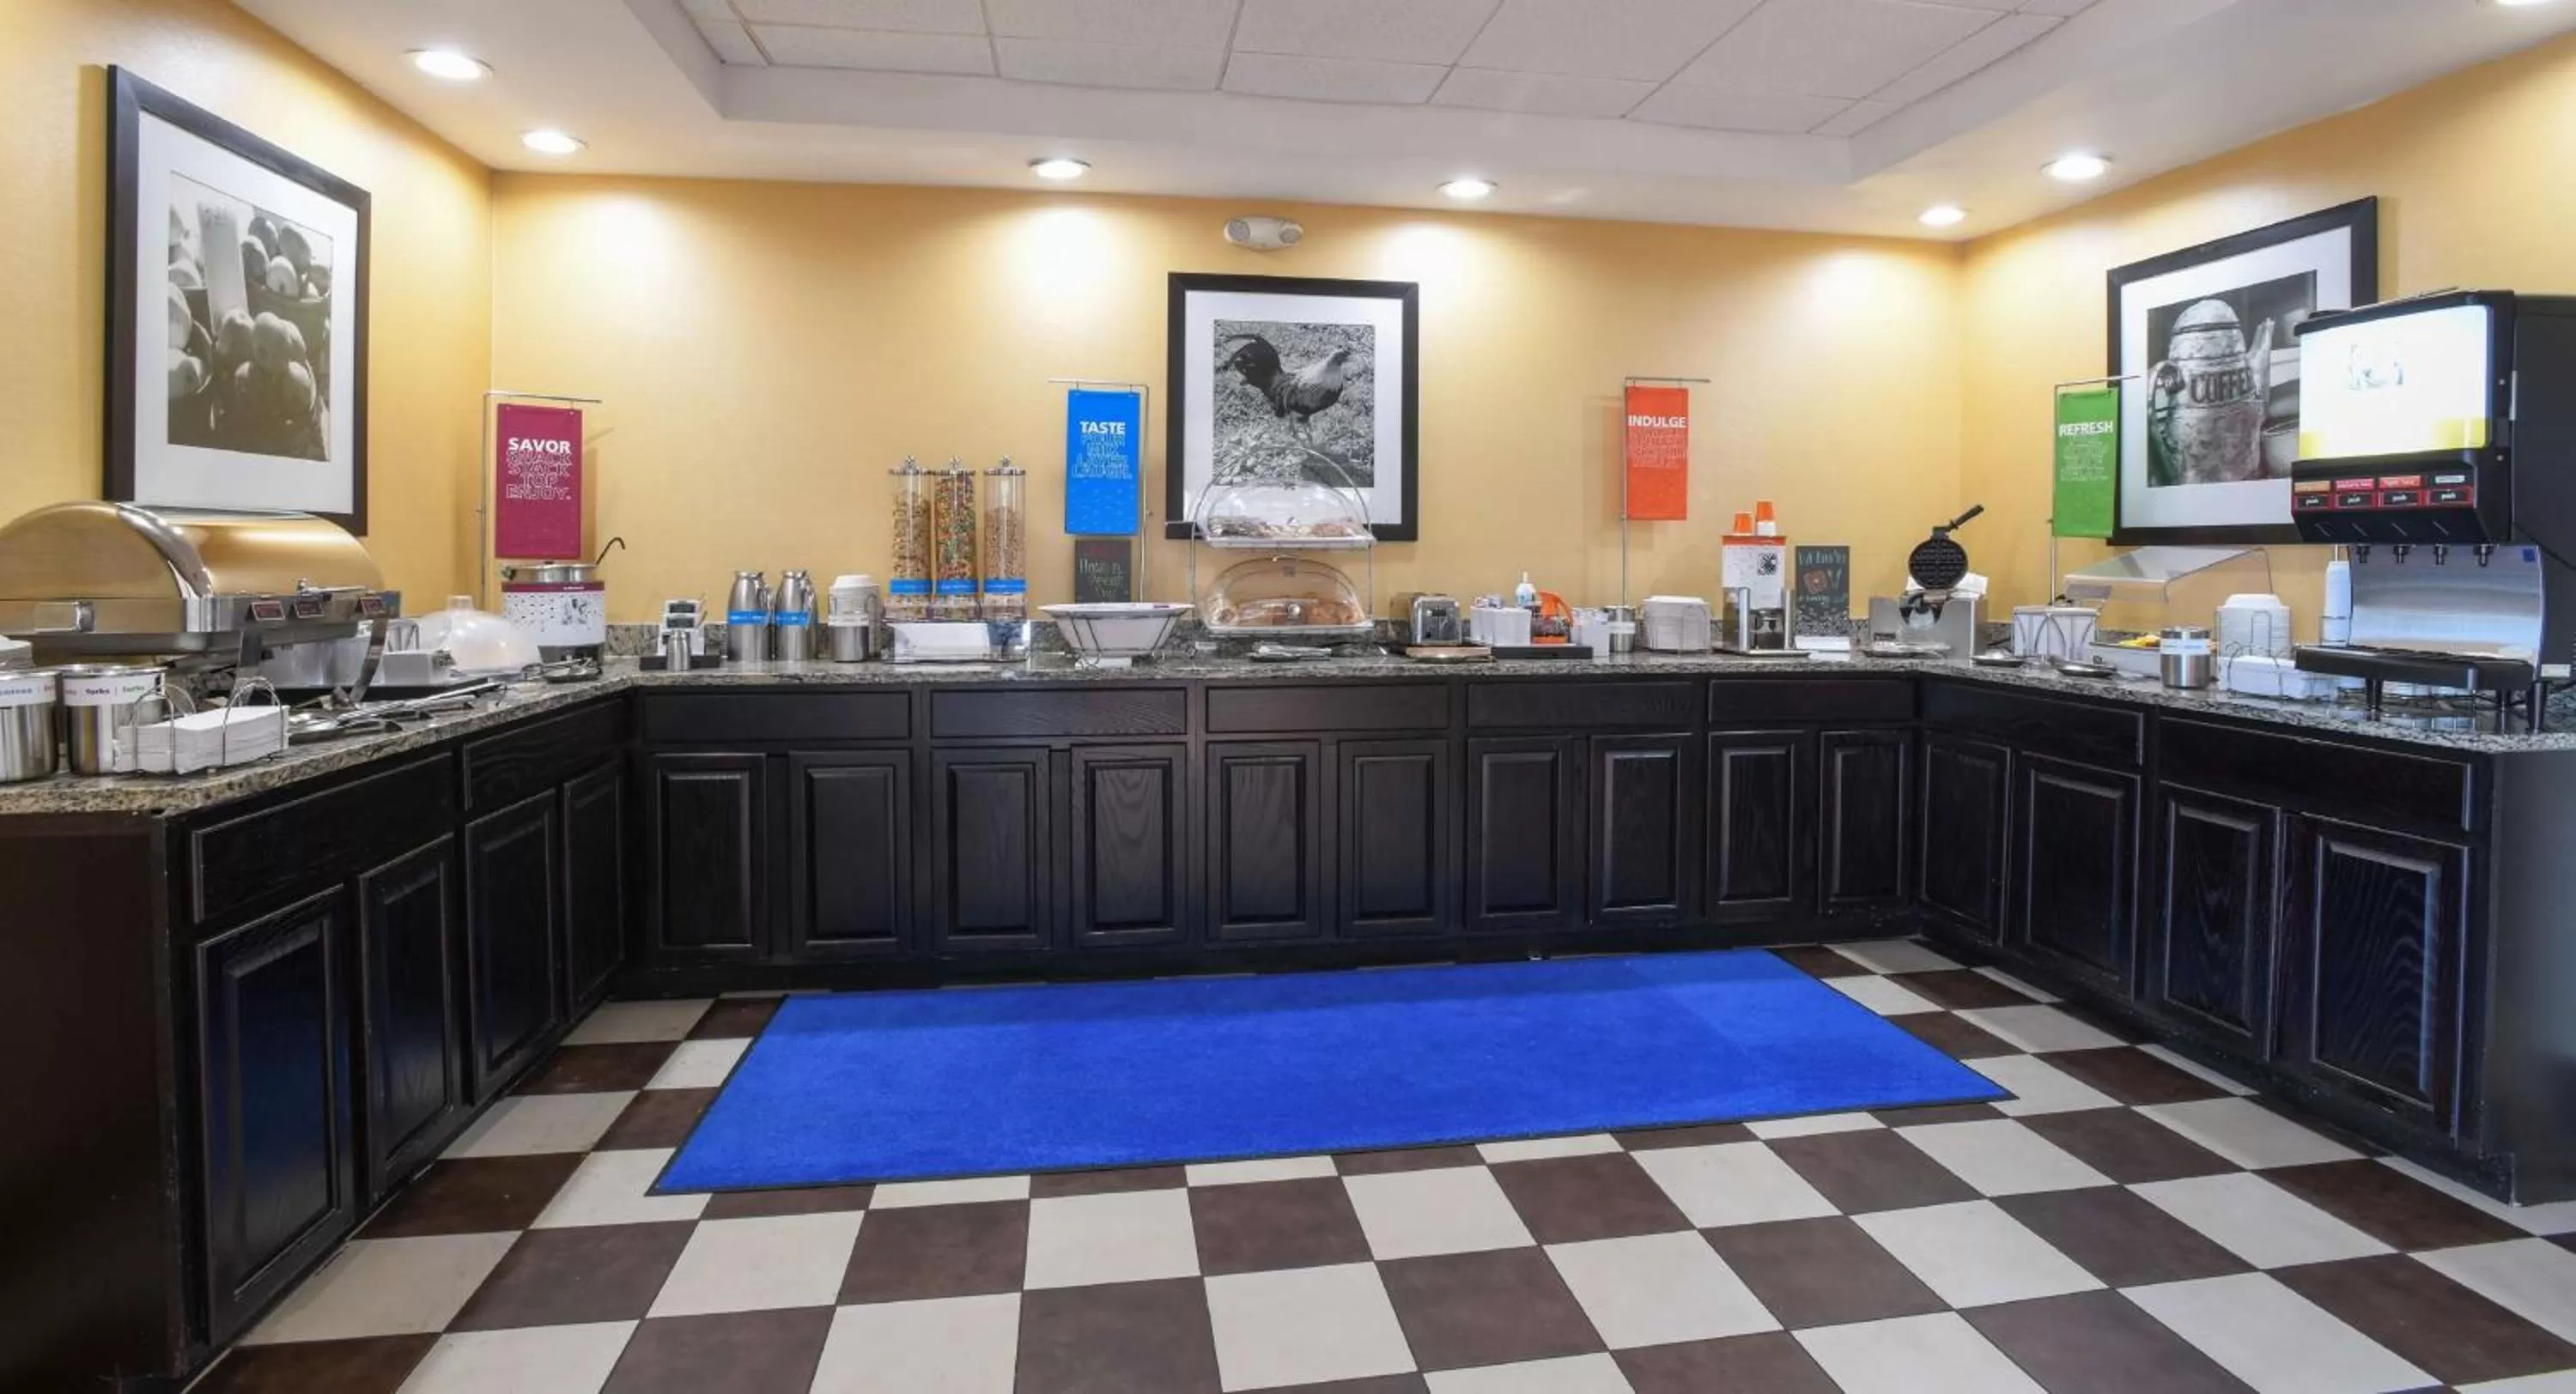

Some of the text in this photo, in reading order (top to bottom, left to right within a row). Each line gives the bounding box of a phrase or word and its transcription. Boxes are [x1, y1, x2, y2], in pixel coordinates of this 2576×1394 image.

[1079, 421, 1127, 435] TASTE
[1627, 415, 1687, 428] INDULGE
[2058, 421, 2114, 439] REFRESH
[508, 438, 571, 455] SAVOR
[523, 472, 558, 489] TOP
[506, 483, 572, 500] ENJOY.
